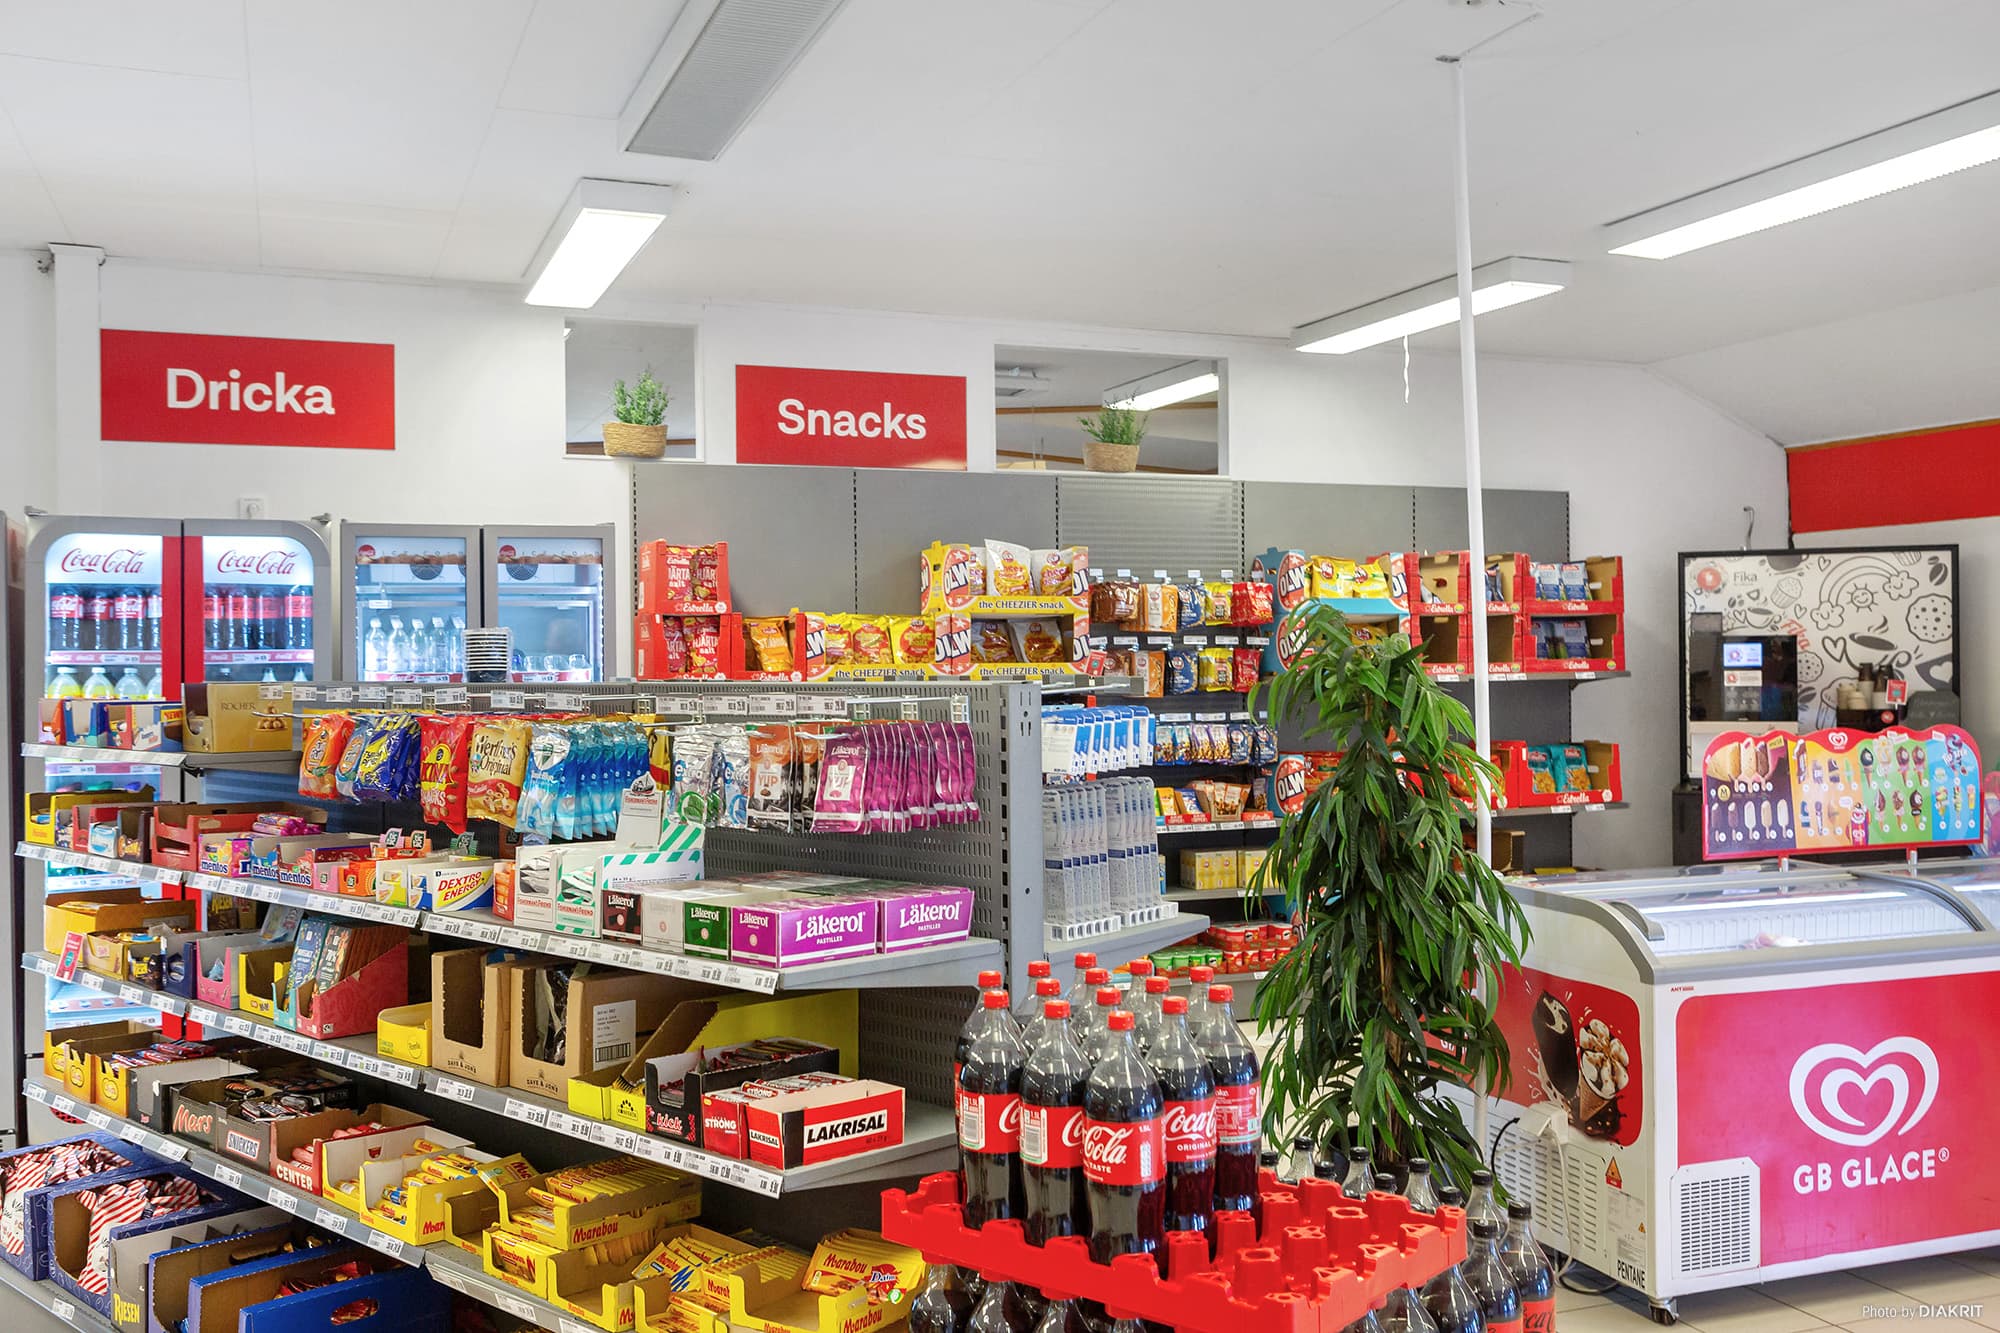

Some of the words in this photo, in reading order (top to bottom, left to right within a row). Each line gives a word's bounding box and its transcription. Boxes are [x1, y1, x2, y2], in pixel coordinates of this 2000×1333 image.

[166, 366, 337, 416] Dricka
[777, 397, 928, 452] Snacks
[1733, 571, 1758, 582] Fika
[683, 601, 715, 613] Estrella
[979, 601, 993, 609] the
[995, 600, 1037, 609] CHEEZIER
[1039, 601, 1064, 609] snack
[836, 669, 850, 678] the
[853, 669, 897, 678] CHEEZIER
[900, 668, 926, 677] snack
[980, 667, 994, 675] the
[996, 666, 1037, 676] CHEEZIER
[1039, 667, 1064, 676] snack
[221, 702, 257, 712] ROCHER
[480, 754, 512, 779] Original
[1562, 792, 1590, 804] Estrella
[201, 860, 230, 873] mentos
[280, 873, 312, 886] mentos
[437, 871, 482, 891] DEXTRO
[443, 878, 480, 902] ENERGY
[608, 895, 635, 909] Läkerol
[690, 907, 720, 920] Läkerol
[739, 911, 769, 928] Läkerol
[899, 900, 963, 929] Läkerol
[795, 911, 866, 942] Läkerol
[172, 1103, 213, 1134] Mars
[705, 1117, 737, 1131] STRONG
[750, 1131, 779, 1147] LAKRISAL
[807, 1114, 886, 1145] LAKRISAL
[228, 1133, 260, 1159] SNICKERS
[1176, 1141, 1211, 1154] ORIGINAL
[276, 1166, 313, 1193] CENTER
[1089, 1165, 1112, 1175] TASTE
[1792, 1163, 1833, 1195] GB
[572, 1221, 618, 1245] Marabou
[822, 1252, 867, 1274] Marabou
[1617, 1260, 1646, 1289] PENTANE
[112, 1292, 140, 1325] RIESEN
[843, 1308, 882, 1333] Marabou
